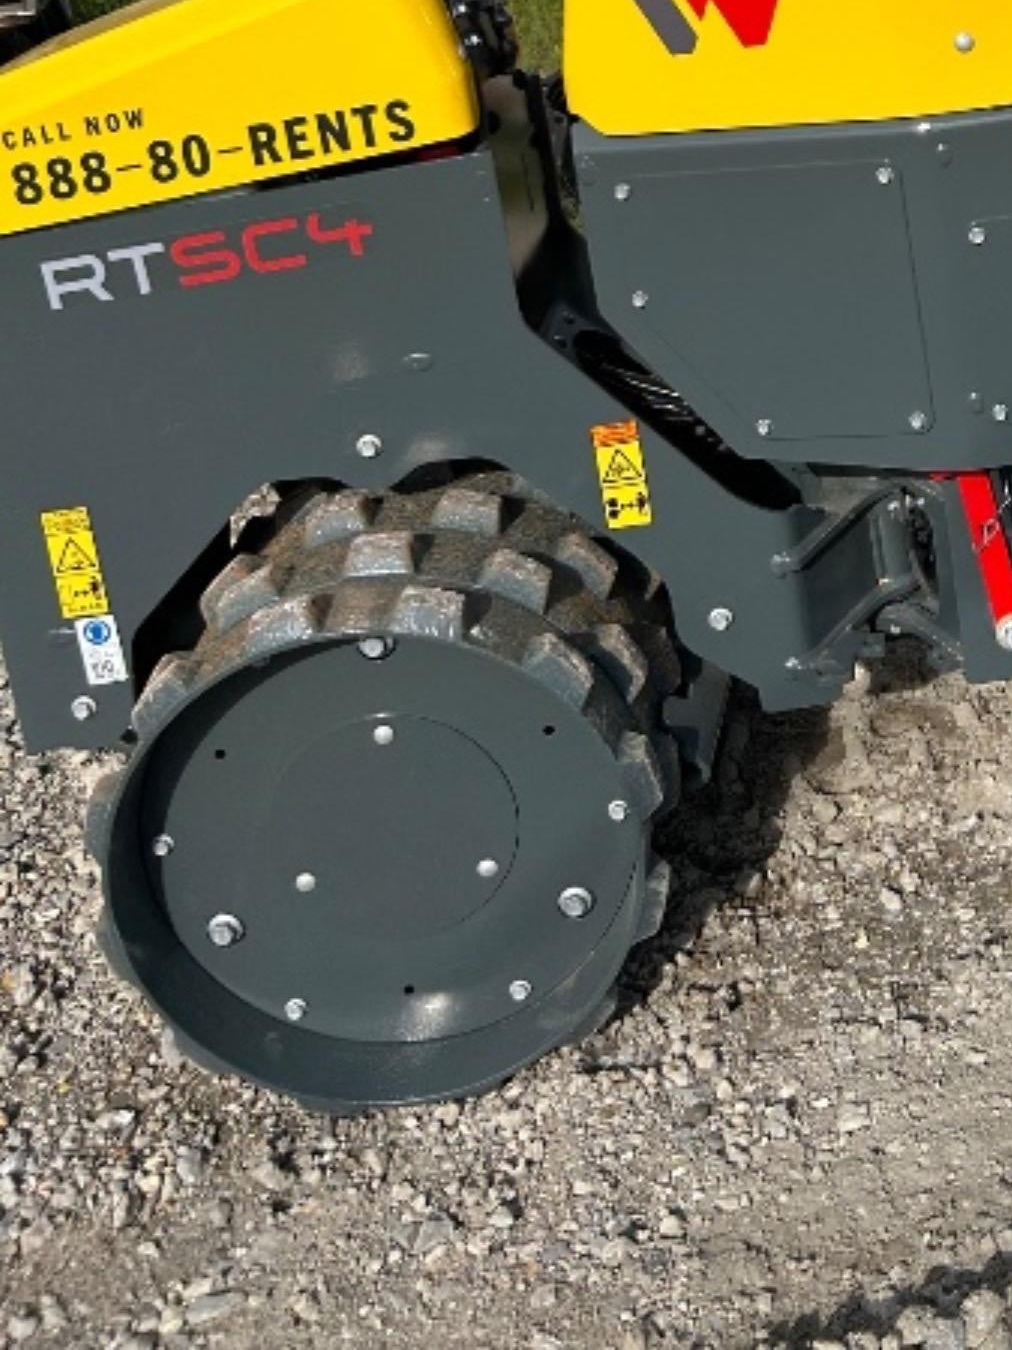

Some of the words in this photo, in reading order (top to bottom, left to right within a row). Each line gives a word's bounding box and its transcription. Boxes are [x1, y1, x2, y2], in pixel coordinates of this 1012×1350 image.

[2, 122, 72, 151] CALL
[84, 108, 144, 136] NOW
[11, 99, 416, 205] 888-80-RENTS
[40, 211, 374, 311] RTSC4
